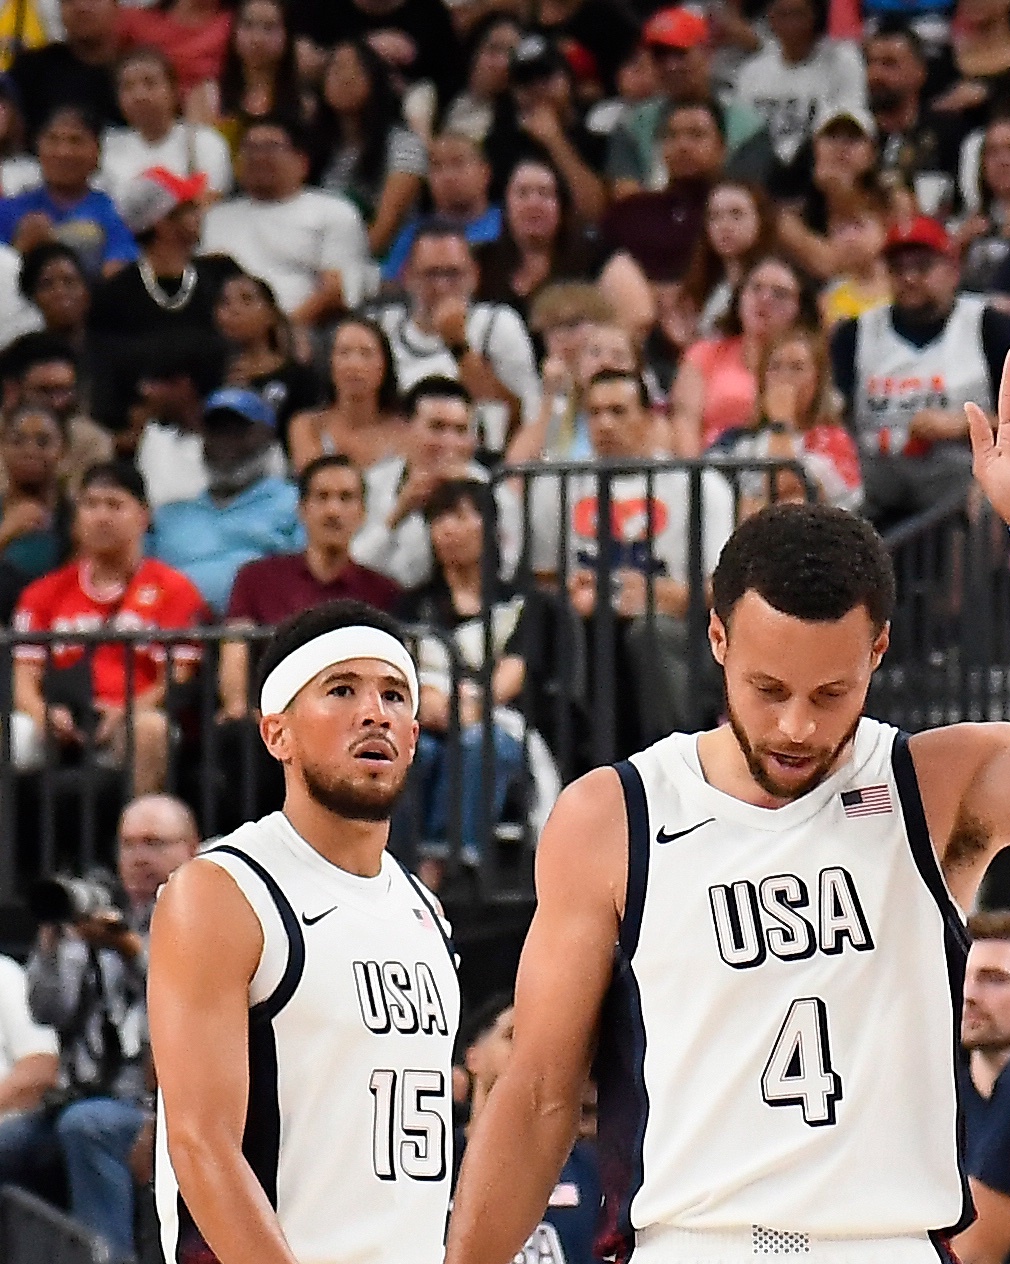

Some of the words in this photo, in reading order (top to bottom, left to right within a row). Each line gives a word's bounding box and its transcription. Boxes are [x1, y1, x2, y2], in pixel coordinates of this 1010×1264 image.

[708, 865, 875, 970] USA
[352, 960, 449, 1036] USA
[760, 996, 843, 1127] 4
[369, 1068, 446, 1182] 15
